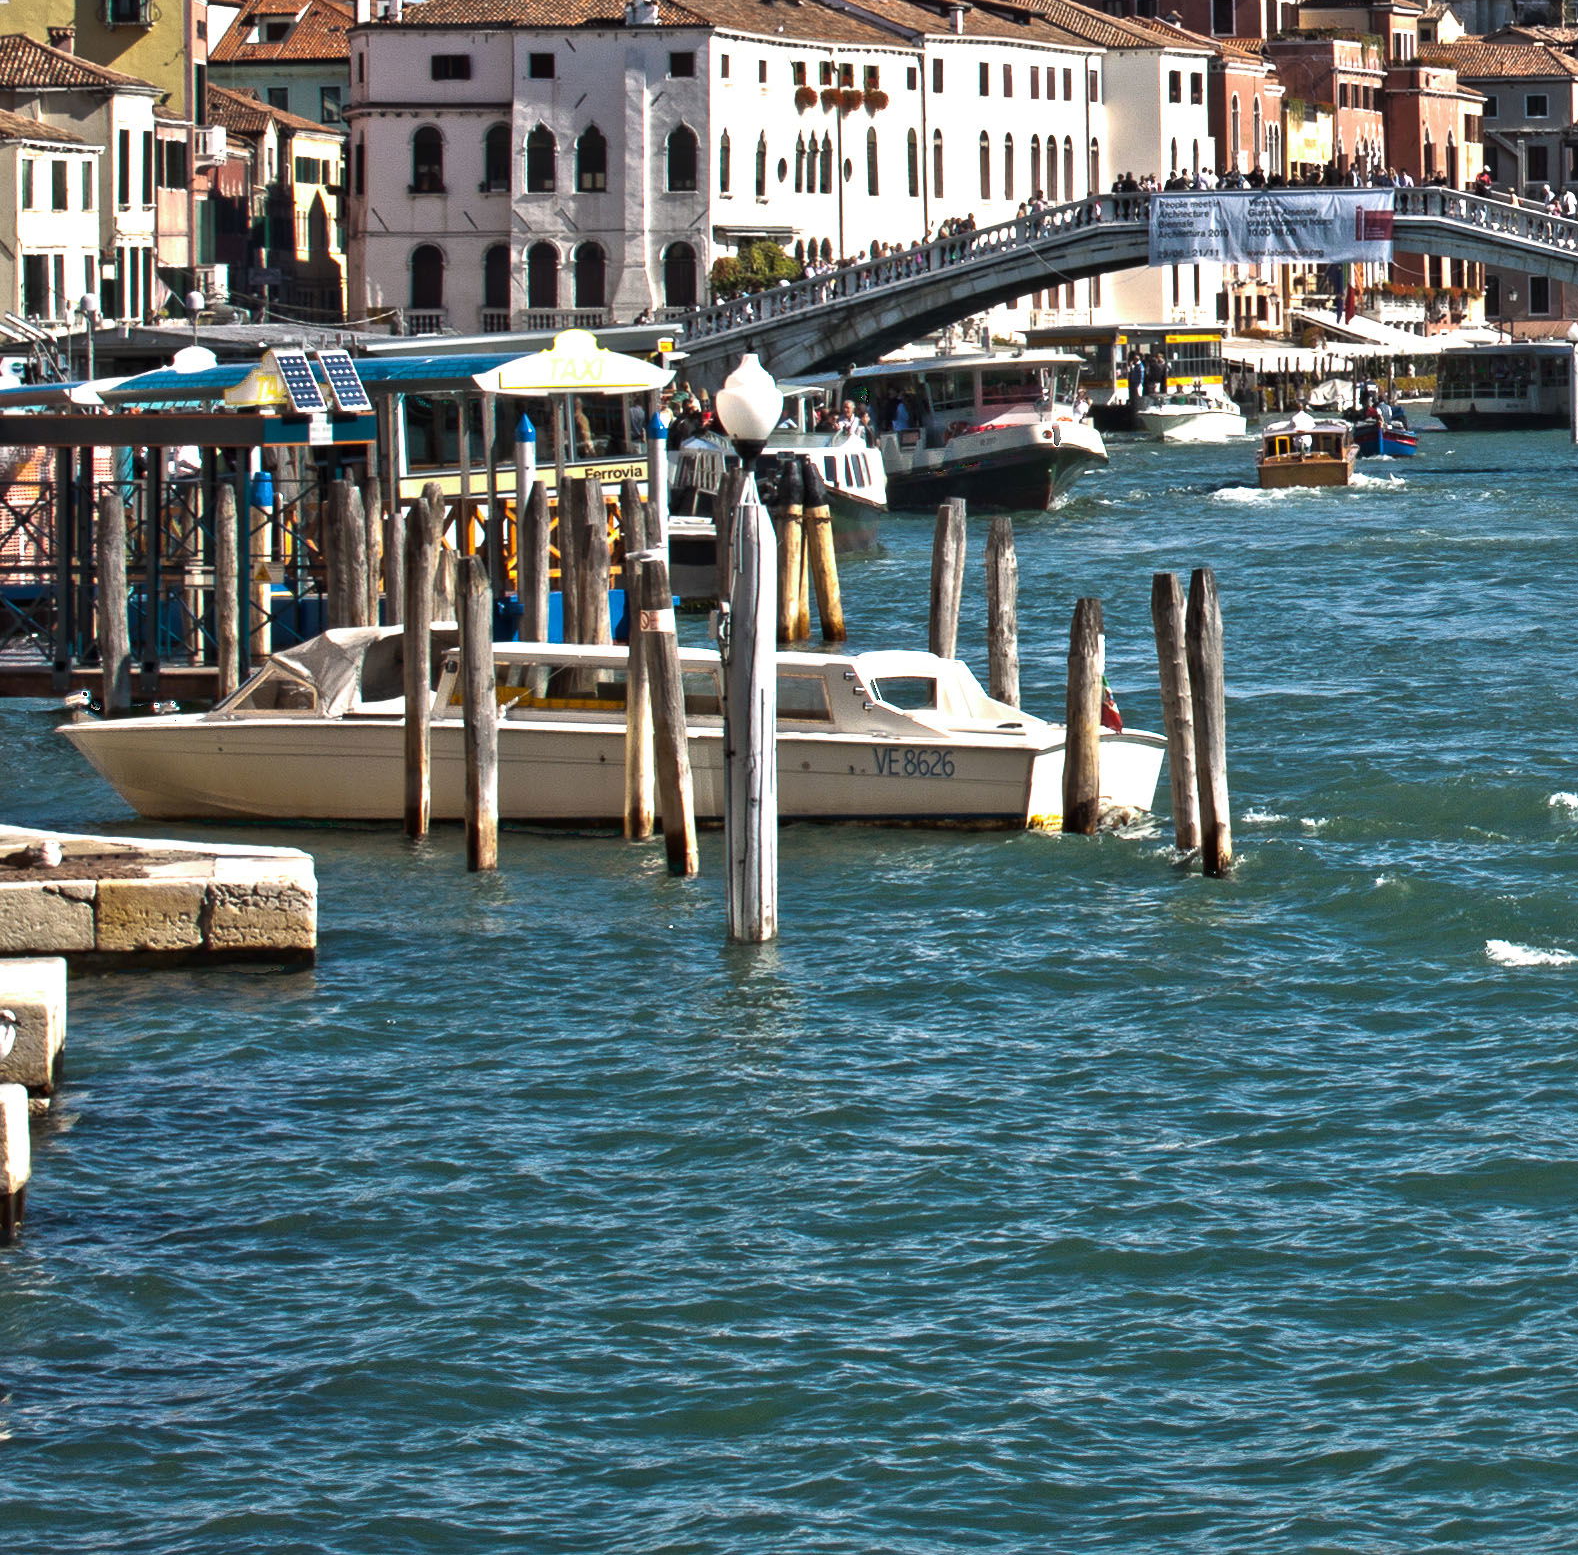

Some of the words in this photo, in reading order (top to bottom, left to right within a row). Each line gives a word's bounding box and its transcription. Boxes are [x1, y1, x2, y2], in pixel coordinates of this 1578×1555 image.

[1159, 209, 1210, 218] Architecture
[1208, 228, 1230, 238] 2010
[1191, 248, 1220, 258] 21/11
[549, 357, 606, 381] TAXI
[584, 465, 644, 480] Ferrovia
[872, 747, 900, 776] VE
[904, 749, 956, 777] 8626
